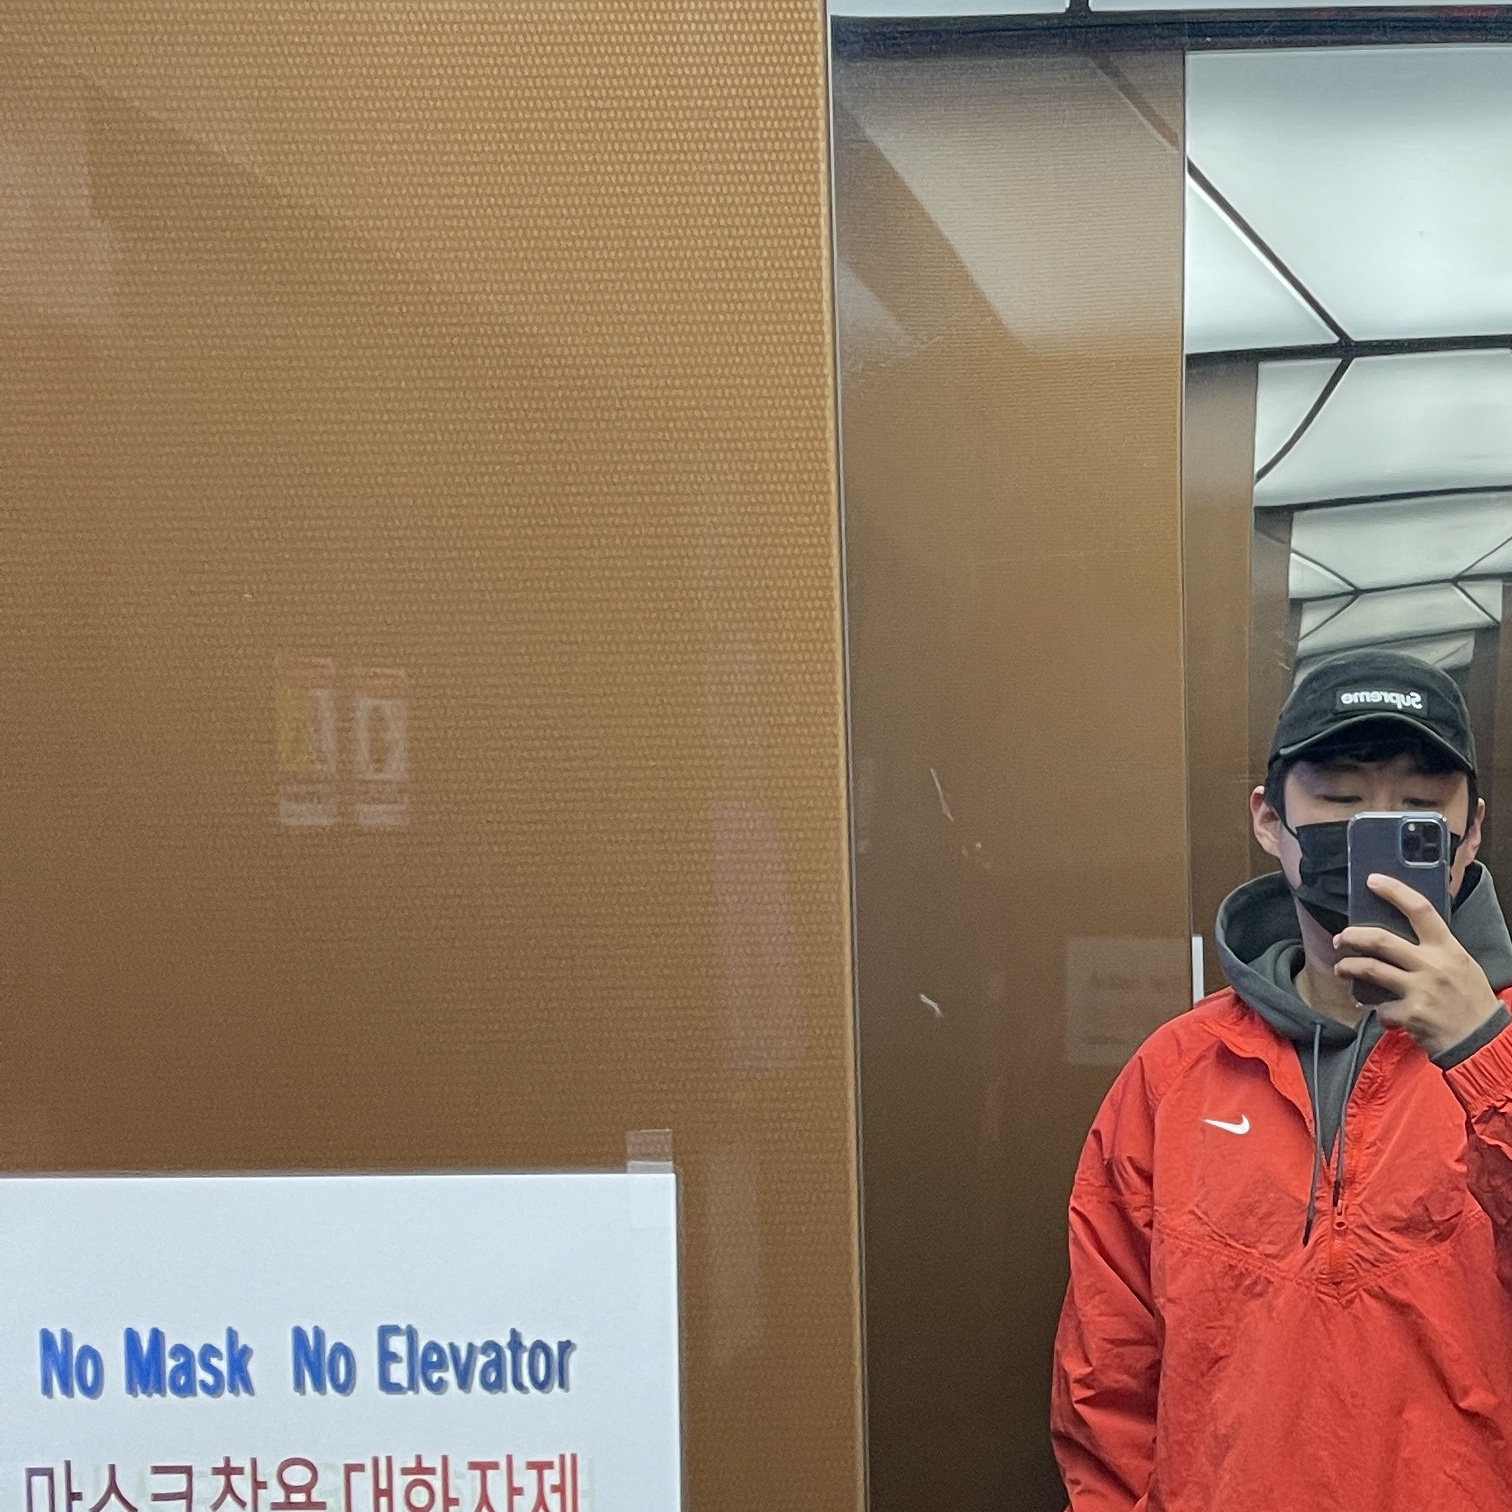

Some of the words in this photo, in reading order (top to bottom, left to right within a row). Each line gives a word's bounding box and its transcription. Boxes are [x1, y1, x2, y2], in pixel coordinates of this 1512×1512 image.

[39, 1328, 104, 1398] No
[124, 1327, 254, 1397] Mask
[291, 1326, 357, 1396] No
[377, 1324, 577, 1396] Elevator
